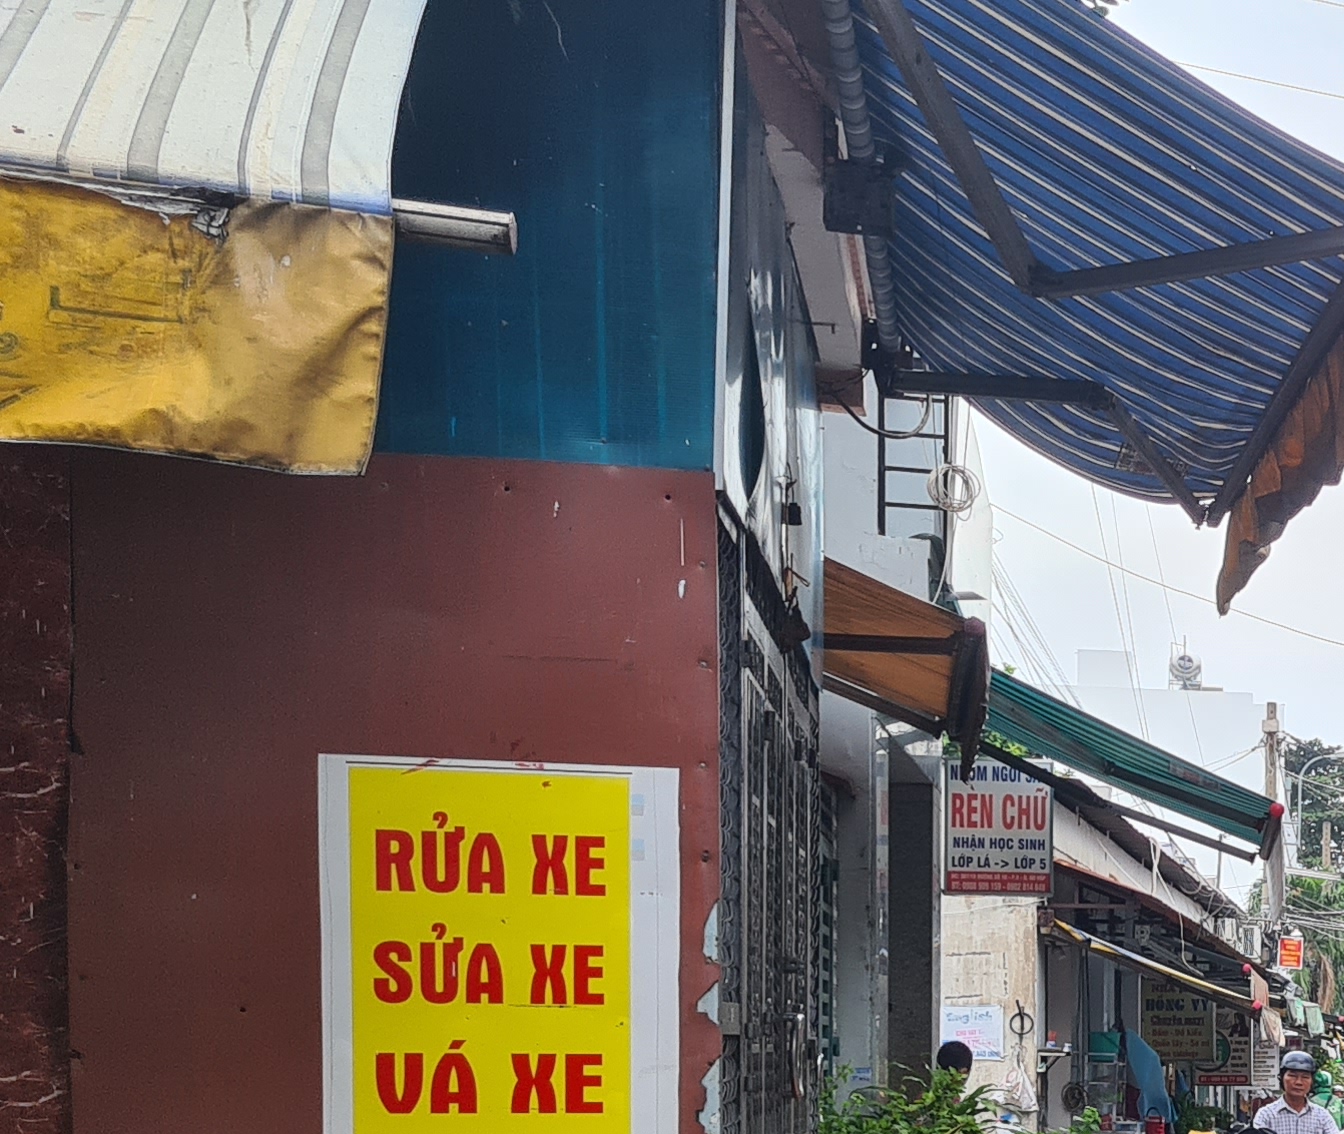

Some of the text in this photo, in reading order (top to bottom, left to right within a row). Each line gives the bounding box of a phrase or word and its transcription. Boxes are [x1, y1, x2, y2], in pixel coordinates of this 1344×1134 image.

[1002, 787, 1049, 830] CHỮ
[375, 811, 606, 896] RỬA XE
[952, 853, 973, 868] LỚP
[977, 853, 991, 868] LÁ
[1014, 854, 1036, 870] LỚP
[1039, 858, 1046, 870] 5
[953, 834, 1046, 852] NHẬN HỌC SINH
[373, 922, 605, 1005] SỬA XE
[375, 1040, 604, 1114] VÁ XE
